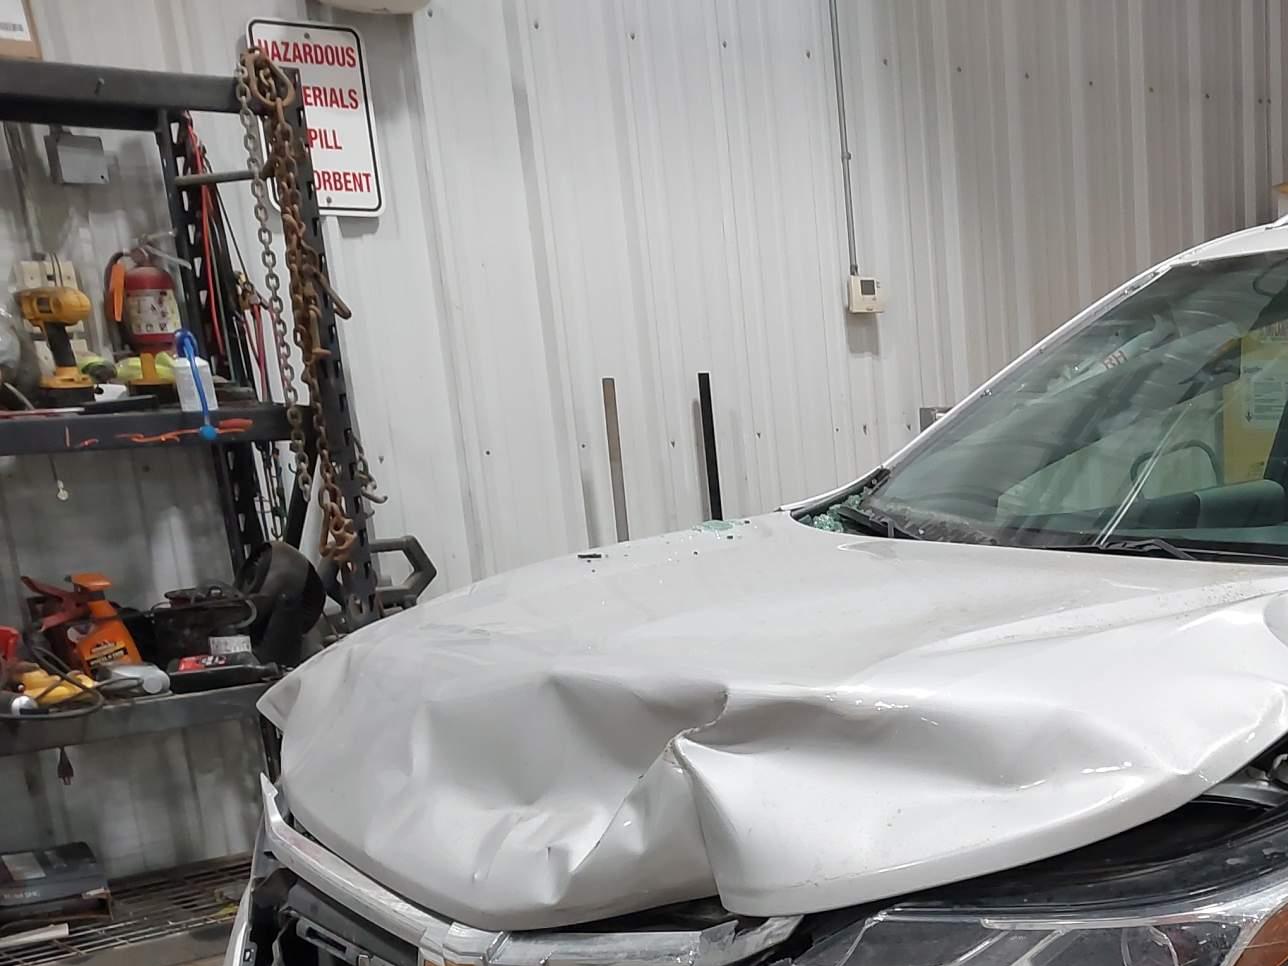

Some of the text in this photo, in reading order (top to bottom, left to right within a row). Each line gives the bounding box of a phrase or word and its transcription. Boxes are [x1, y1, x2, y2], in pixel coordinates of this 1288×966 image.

[258, 39, 356, 68] HAZARDOUS
[302, 86, 359, 109] ERIALS
[307, 128, 343, 150] PILL
[313, 170, 372, 193] ORBENT
